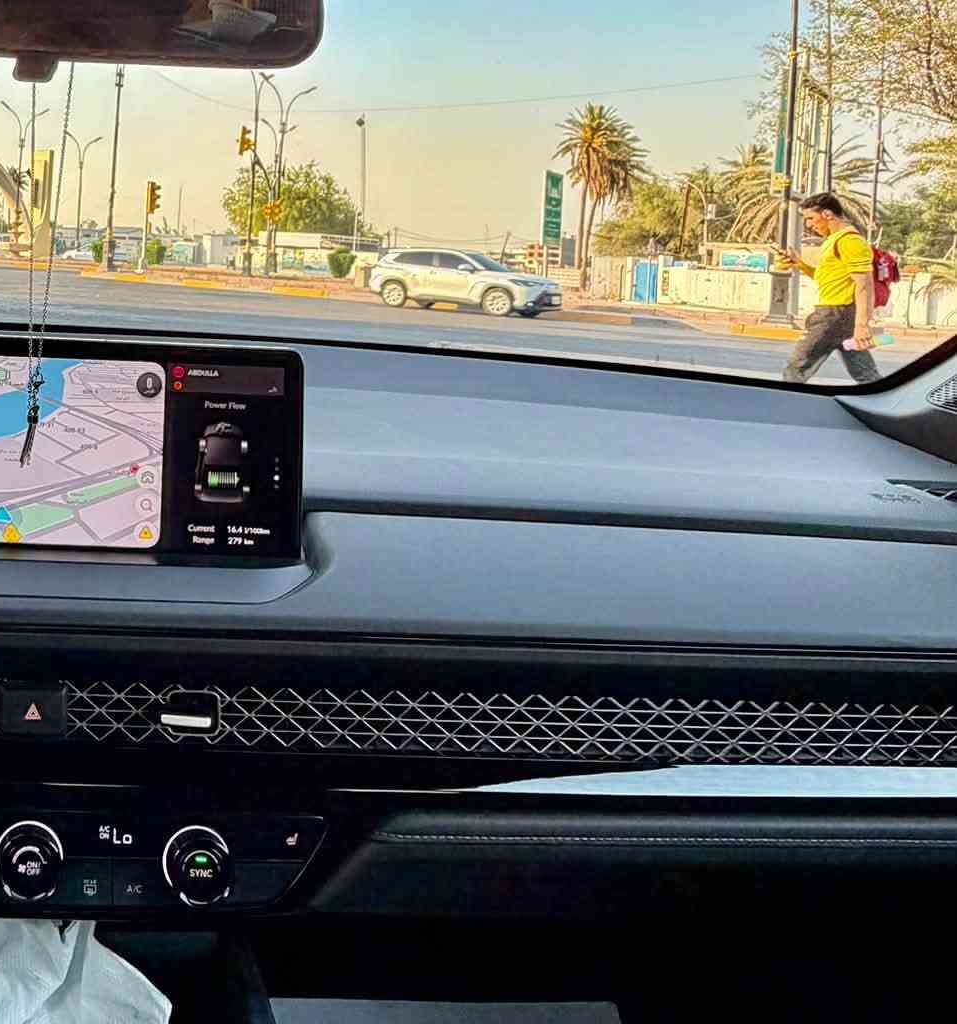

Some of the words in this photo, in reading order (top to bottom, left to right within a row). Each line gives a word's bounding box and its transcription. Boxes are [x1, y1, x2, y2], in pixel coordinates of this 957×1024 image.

[204, 400, 227, 410] Power
[228, 401, 247, 411] Flow
[187, 524, 216, 533] Current
[227, 525, 243, 534] 16.4
[192, 535, 215, 545] Range
[227, 536, 243, 545] 279
[243, 537, 255, 545] km
[98, 825, 111, 833] A/C
[99, 832, 110, 840] ON
[112, 827, 133, 845] Lo
[26, 868, 41, 876] OFF
[189, 868, 213, 878] SYNC
[126, 884, 143, 894] A/C
